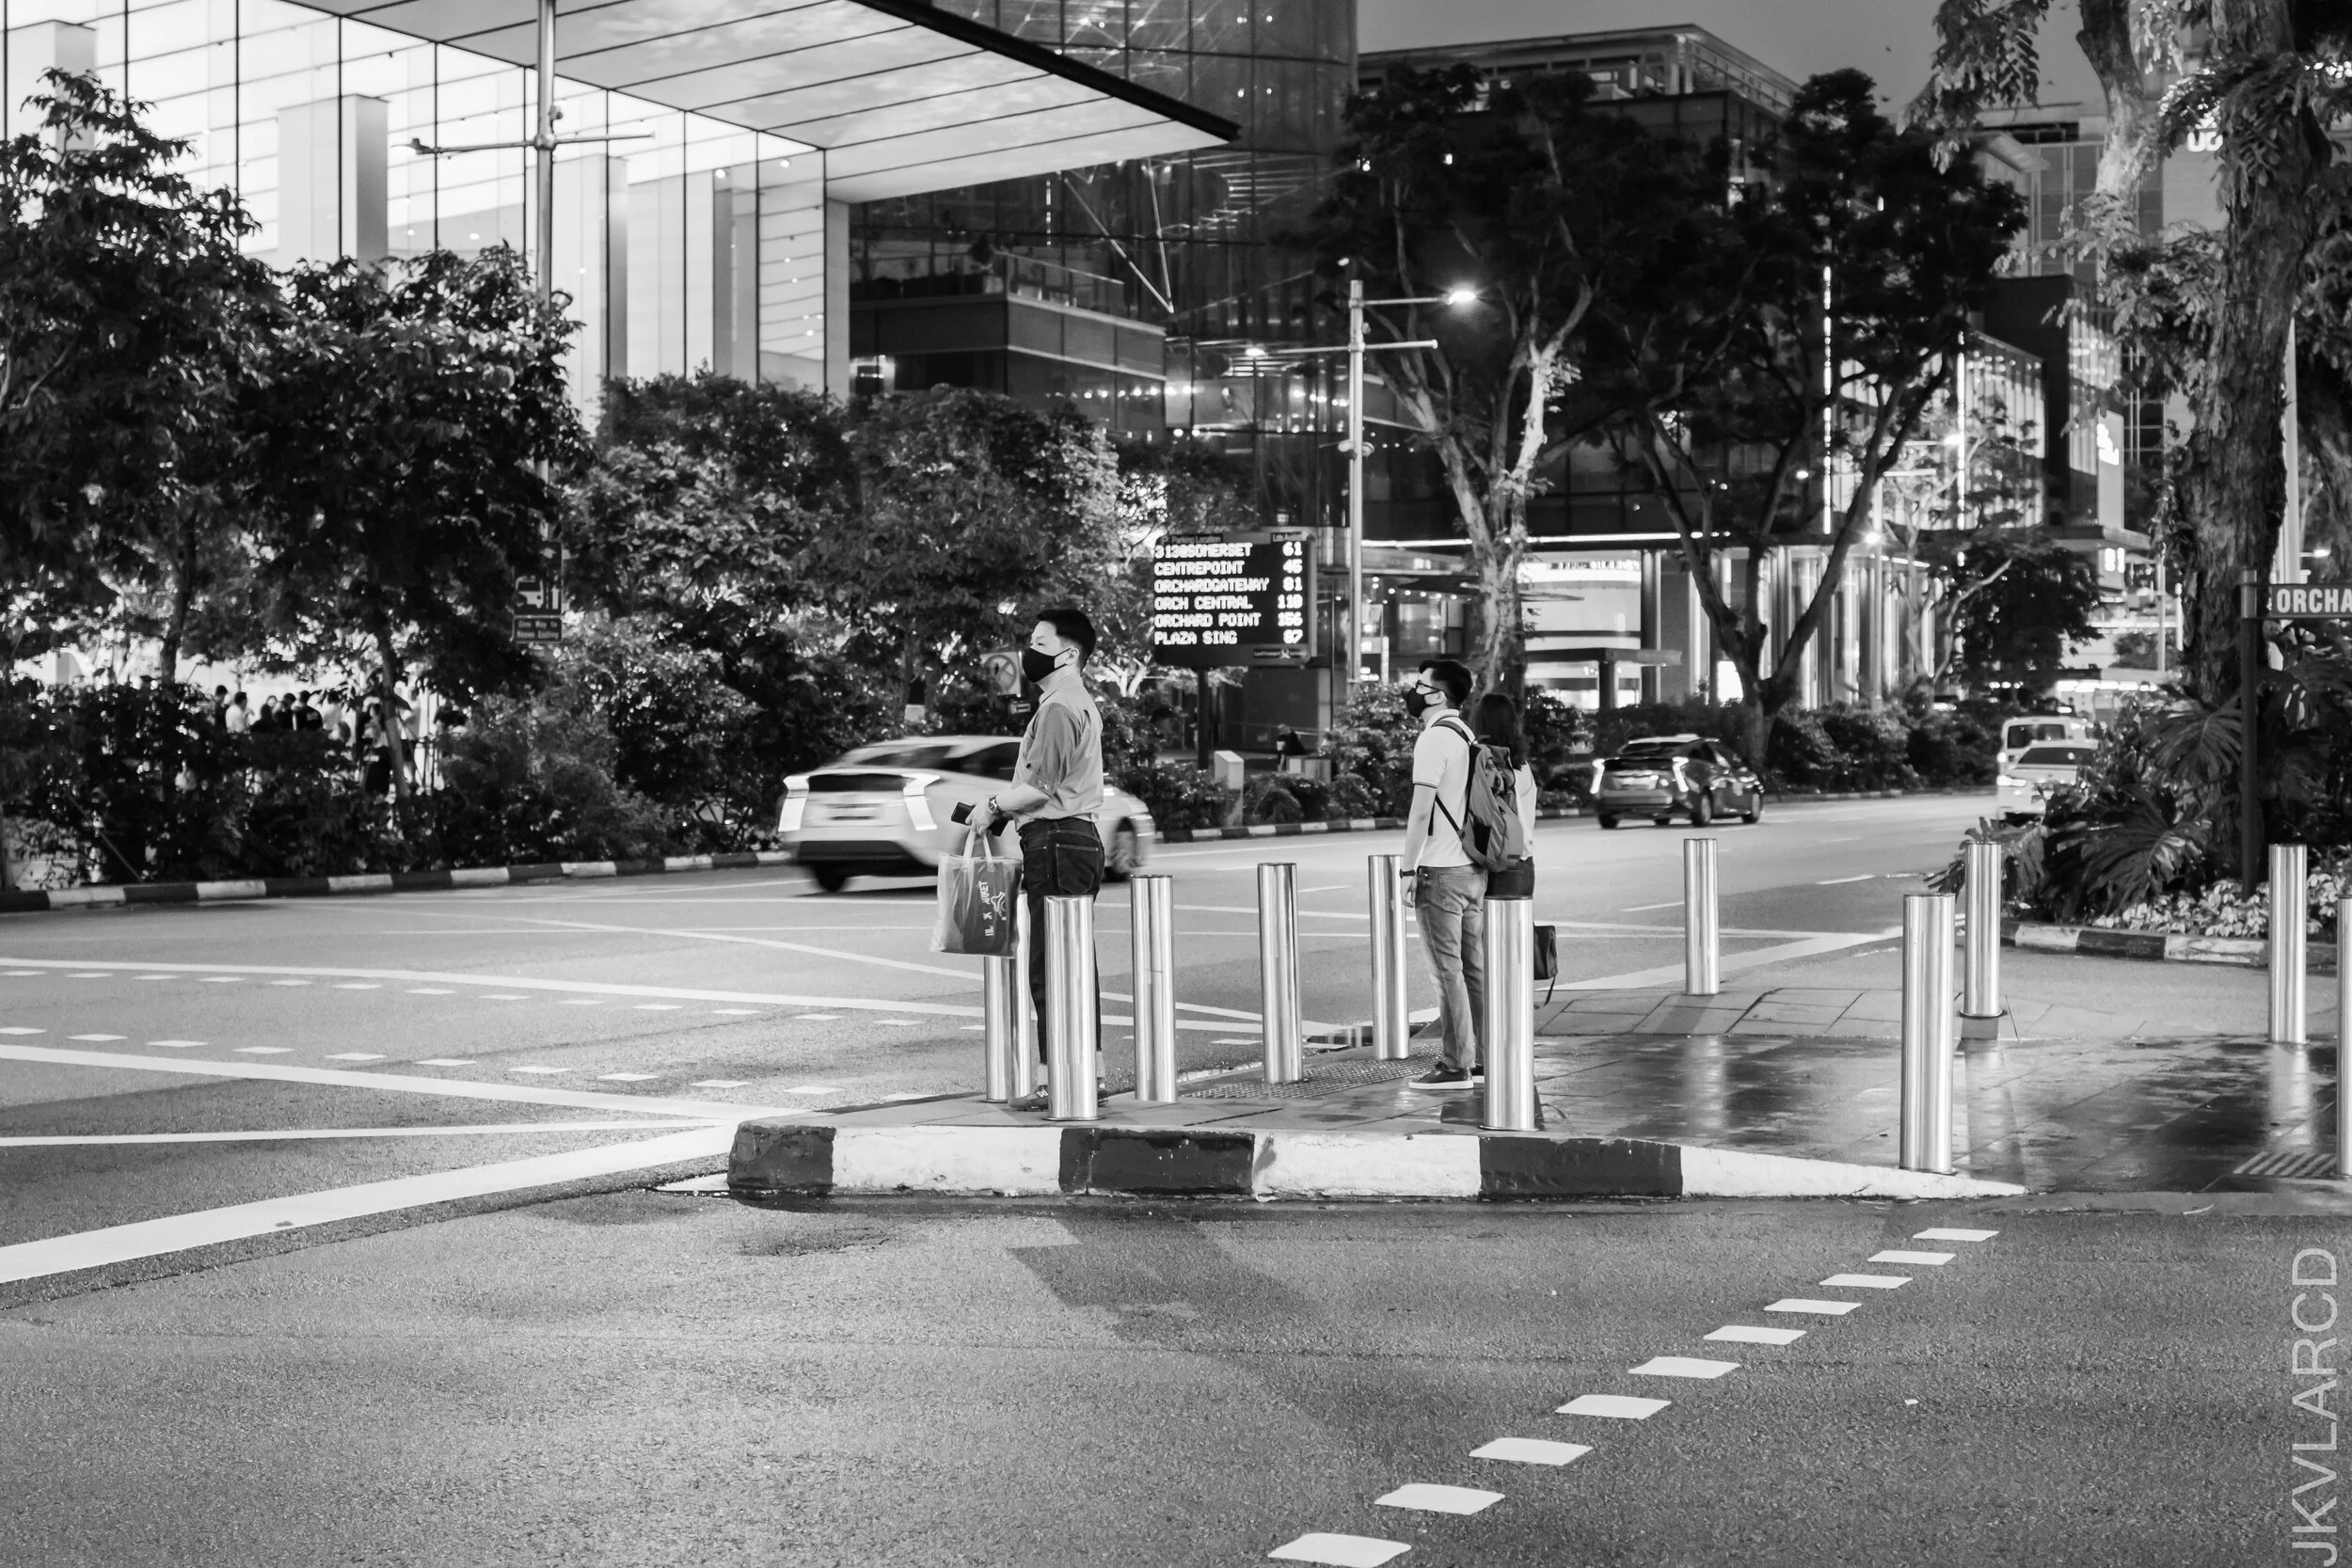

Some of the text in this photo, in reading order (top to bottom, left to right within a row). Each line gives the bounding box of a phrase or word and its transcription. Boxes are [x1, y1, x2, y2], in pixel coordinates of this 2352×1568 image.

[1283, 542, 1302, 556] 61
[1154, 561, 1245, 576] CENTREPOINT
[1283, 559, 1302, 574] 45
[1154, 578, 1269, 593] ORCHARDGATEWAY
[1154, 595, 1253, 610] ORCH CENTRAL
[2277, 588, 2352, 613] ORCHA
[1153, 612, 1261, 628] ORCHARD POINT
[1278, 611, 1303, 626] 156
[1154, 630, 1237, 644] PLAZA SING
